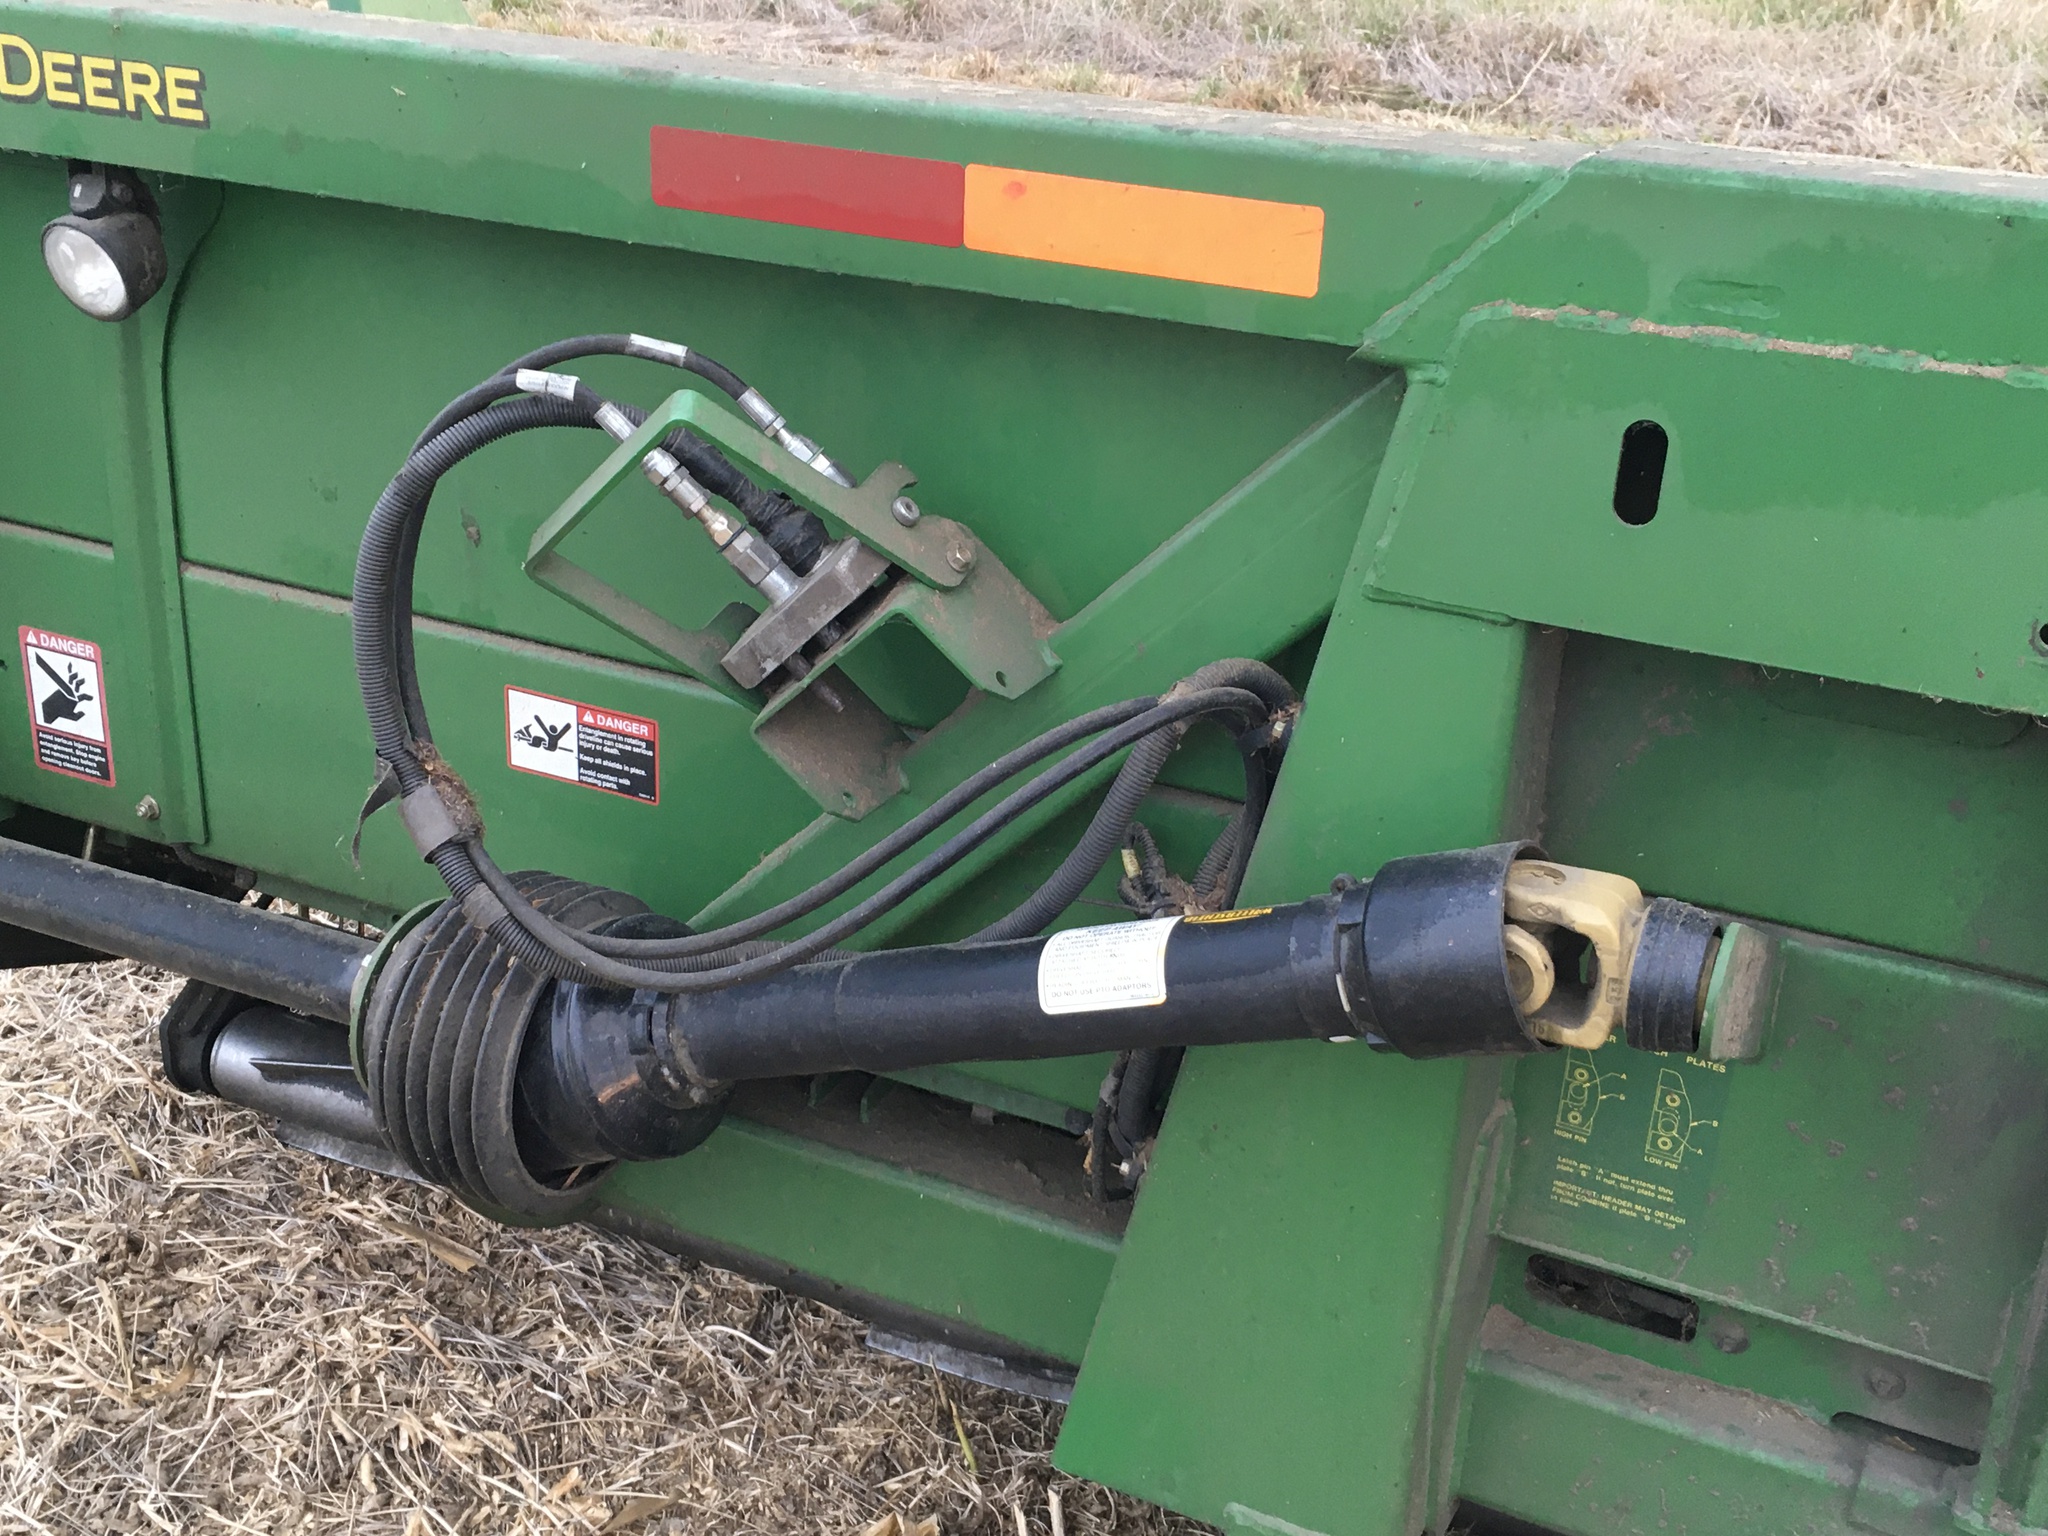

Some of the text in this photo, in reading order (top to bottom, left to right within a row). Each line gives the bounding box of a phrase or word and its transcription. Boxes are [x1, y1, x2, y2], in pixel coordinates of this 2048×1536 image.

[0, 32, 207, 126] DEERE
[40, 633, 95, 658] DANGER
[597, 714, 649, 736] DANGER
[578, 724, 617, 740] Entanglement
[624, 737, 647, 749] rotating
[578, 732, 603, 743] driveline
[615, 742, 632, 751] cause
[632, 746, 653, 756] serious
[579, 740, 595, 750] injury
[602, 746, 621, 755] death.
[579, 752, 595, 763] Keep
[602, 759, 623, 770] shields
[630, 766, 647, 776] place.
[579, 766, 631, 785] Avoid contact with
[579, 775, 619, 789] rotating parts.
[1063, 989, 1078, 997] NOT
[1112, 982, 1152, 993] ADAPTORS
[1686, 1056, 1727, 1074] PLATES
[1620, 1073, 1627, 1081] A
[1712, 1119, 1720, 1128] B
[1554, 1128, 1588, 1144] HIGH PIN
[1696, 1148, 1704, 1156] A
[1644, 1154, 1679, 1170] LOW PIN
[1557, 1155, 1578, 1167] Latch
[1579, 1162, 1592, 1171] pin
[1610, 1172, 1629, 1182] must
[1630, 1179, 1656, 1190] extend
[1658, 1186, 1674, 1196] thru
[1620, 1182, 1635, 1192] turn
[1636, 1188, 1656, 1199] plate
[1601, 1194, 1633, 1208] HEADER
[1634, 1204, 1652, 1214] MAY
[1654, 1210, 1686, 1225] DETACH
[1618, 1208, 1637, 1218] plate
